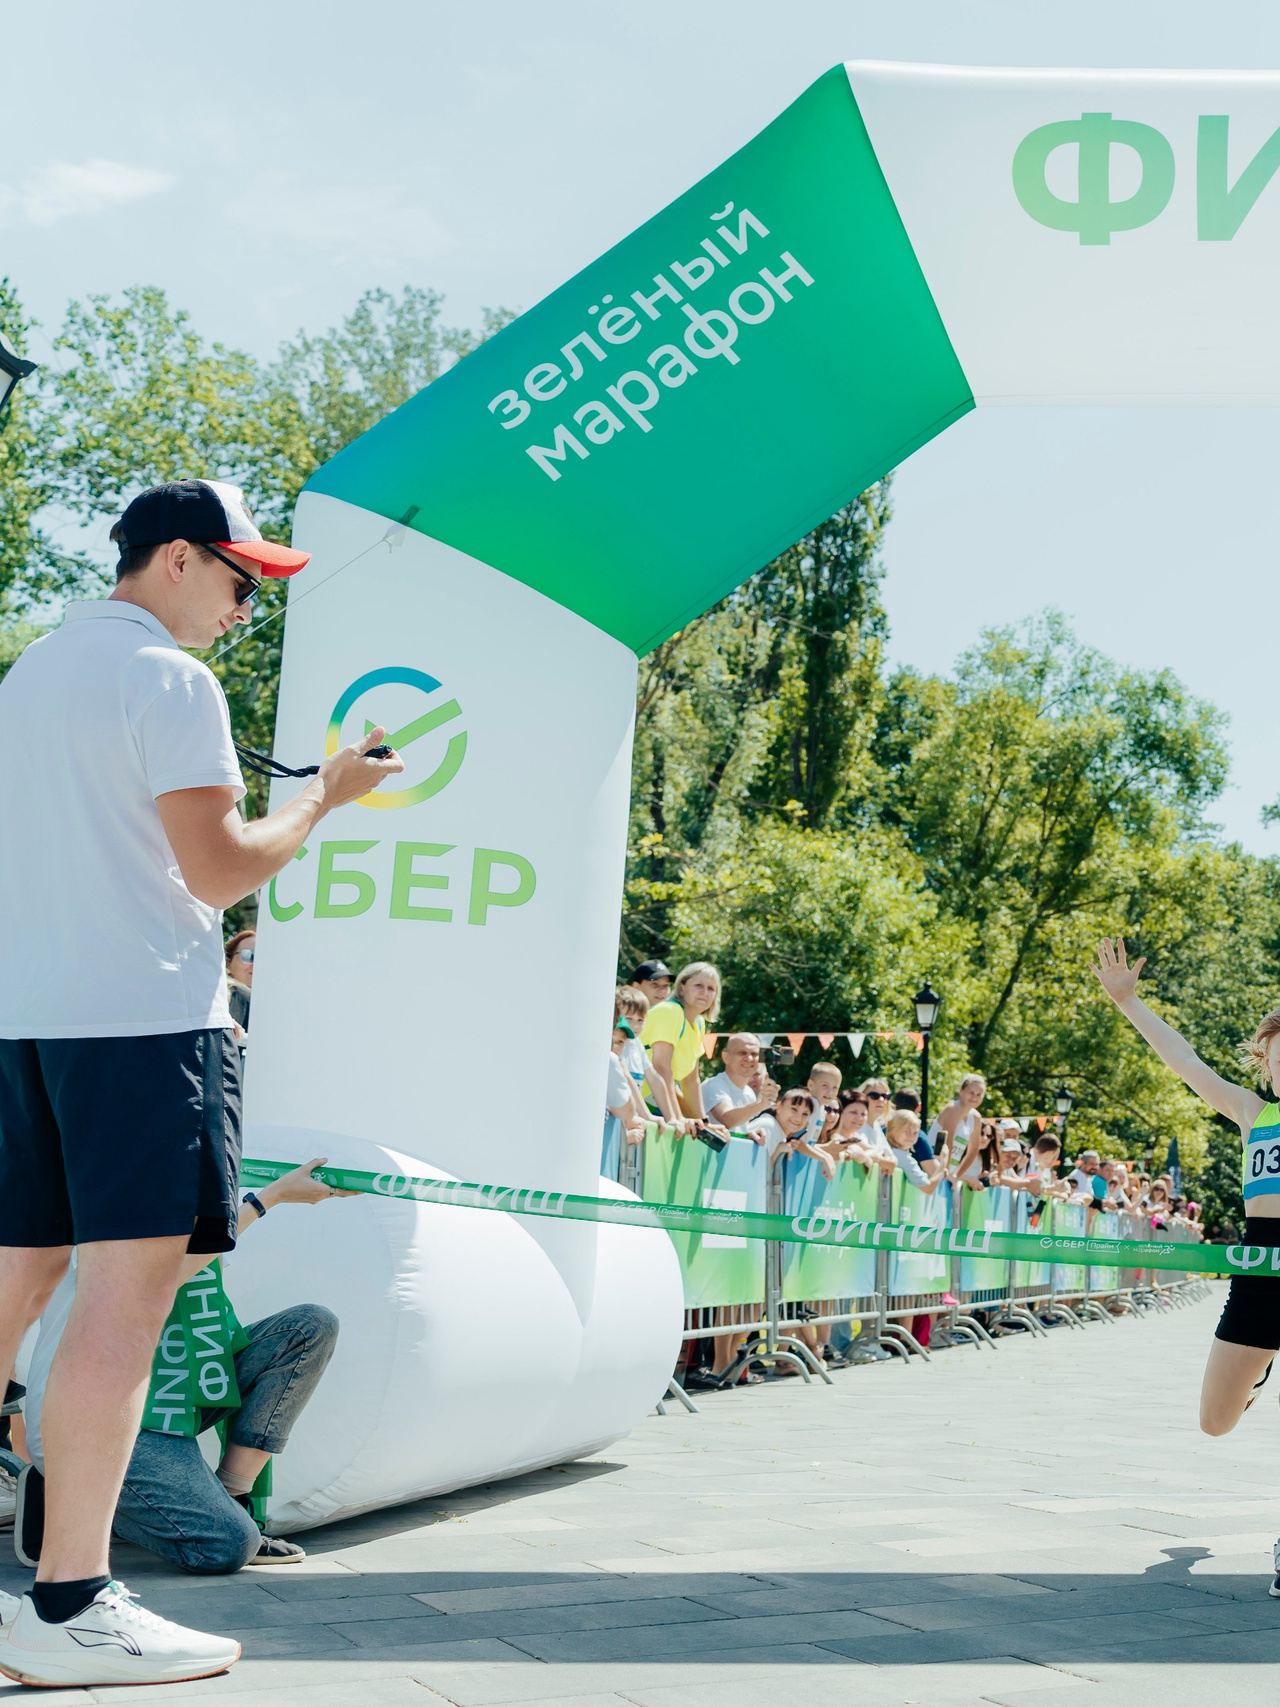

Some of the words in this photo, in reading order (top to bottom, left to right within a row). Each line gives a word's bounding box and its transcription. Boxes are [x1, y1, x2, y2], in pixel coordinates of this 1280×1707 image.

[487, 200, 771, 430] зелёный
[525, 250, 816, 482] марафон
[372, 1171, 567, 1216] ФИНИШ
[661, 1207, 685, 1217] Прайм
[791, 1216, 994, 1254] ФИНИШ
[1055, 1239, 1086, 1249] СБЕР
[1090, 1241, 1115, 1251] Прайм
